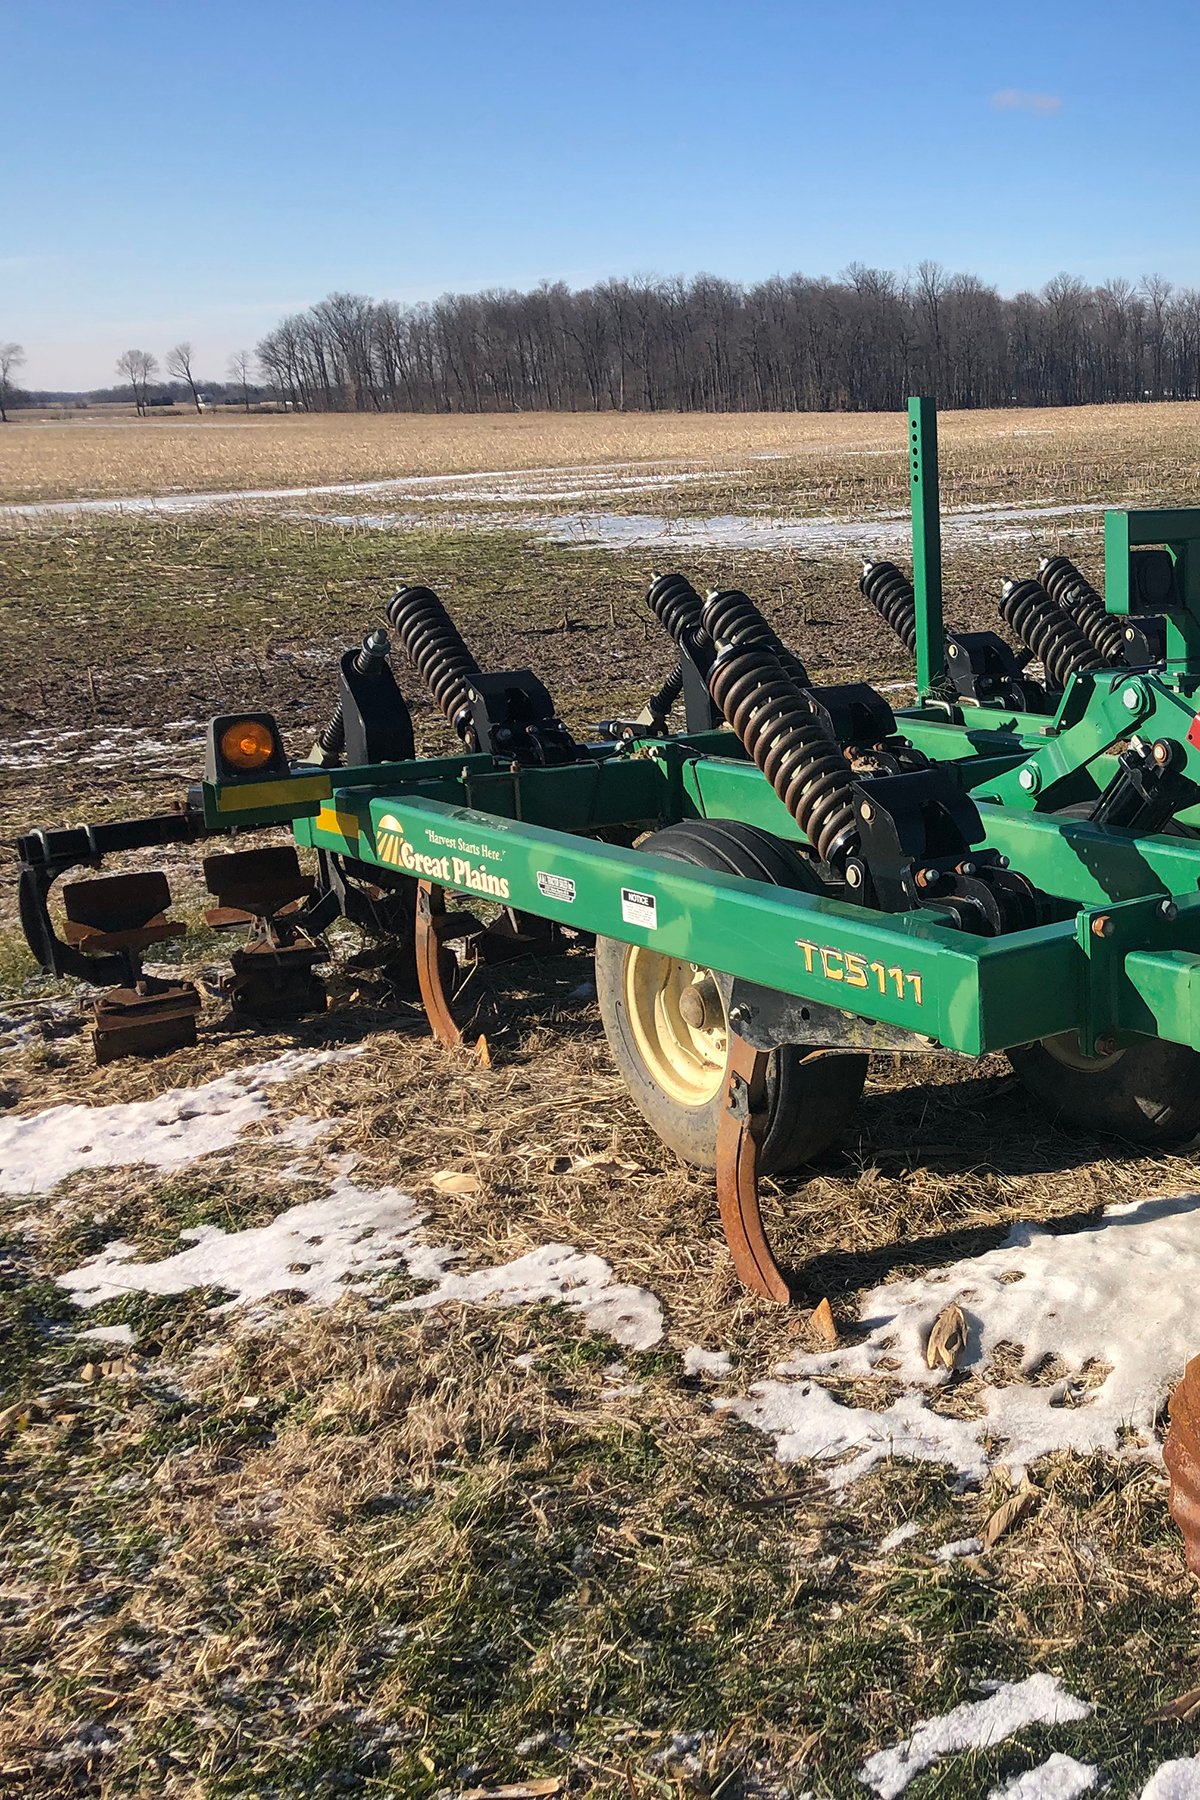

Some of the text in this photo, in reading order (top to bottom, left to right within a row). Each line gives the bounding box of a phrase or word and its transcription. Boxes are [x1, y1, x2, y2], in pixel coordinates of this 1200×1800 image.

[458, 838, 480, 856] Starts
[400, 842, 451, 881] Great
[451, 857, 510, 899] Plains
[628, 892, 650, 906] NOTICE
